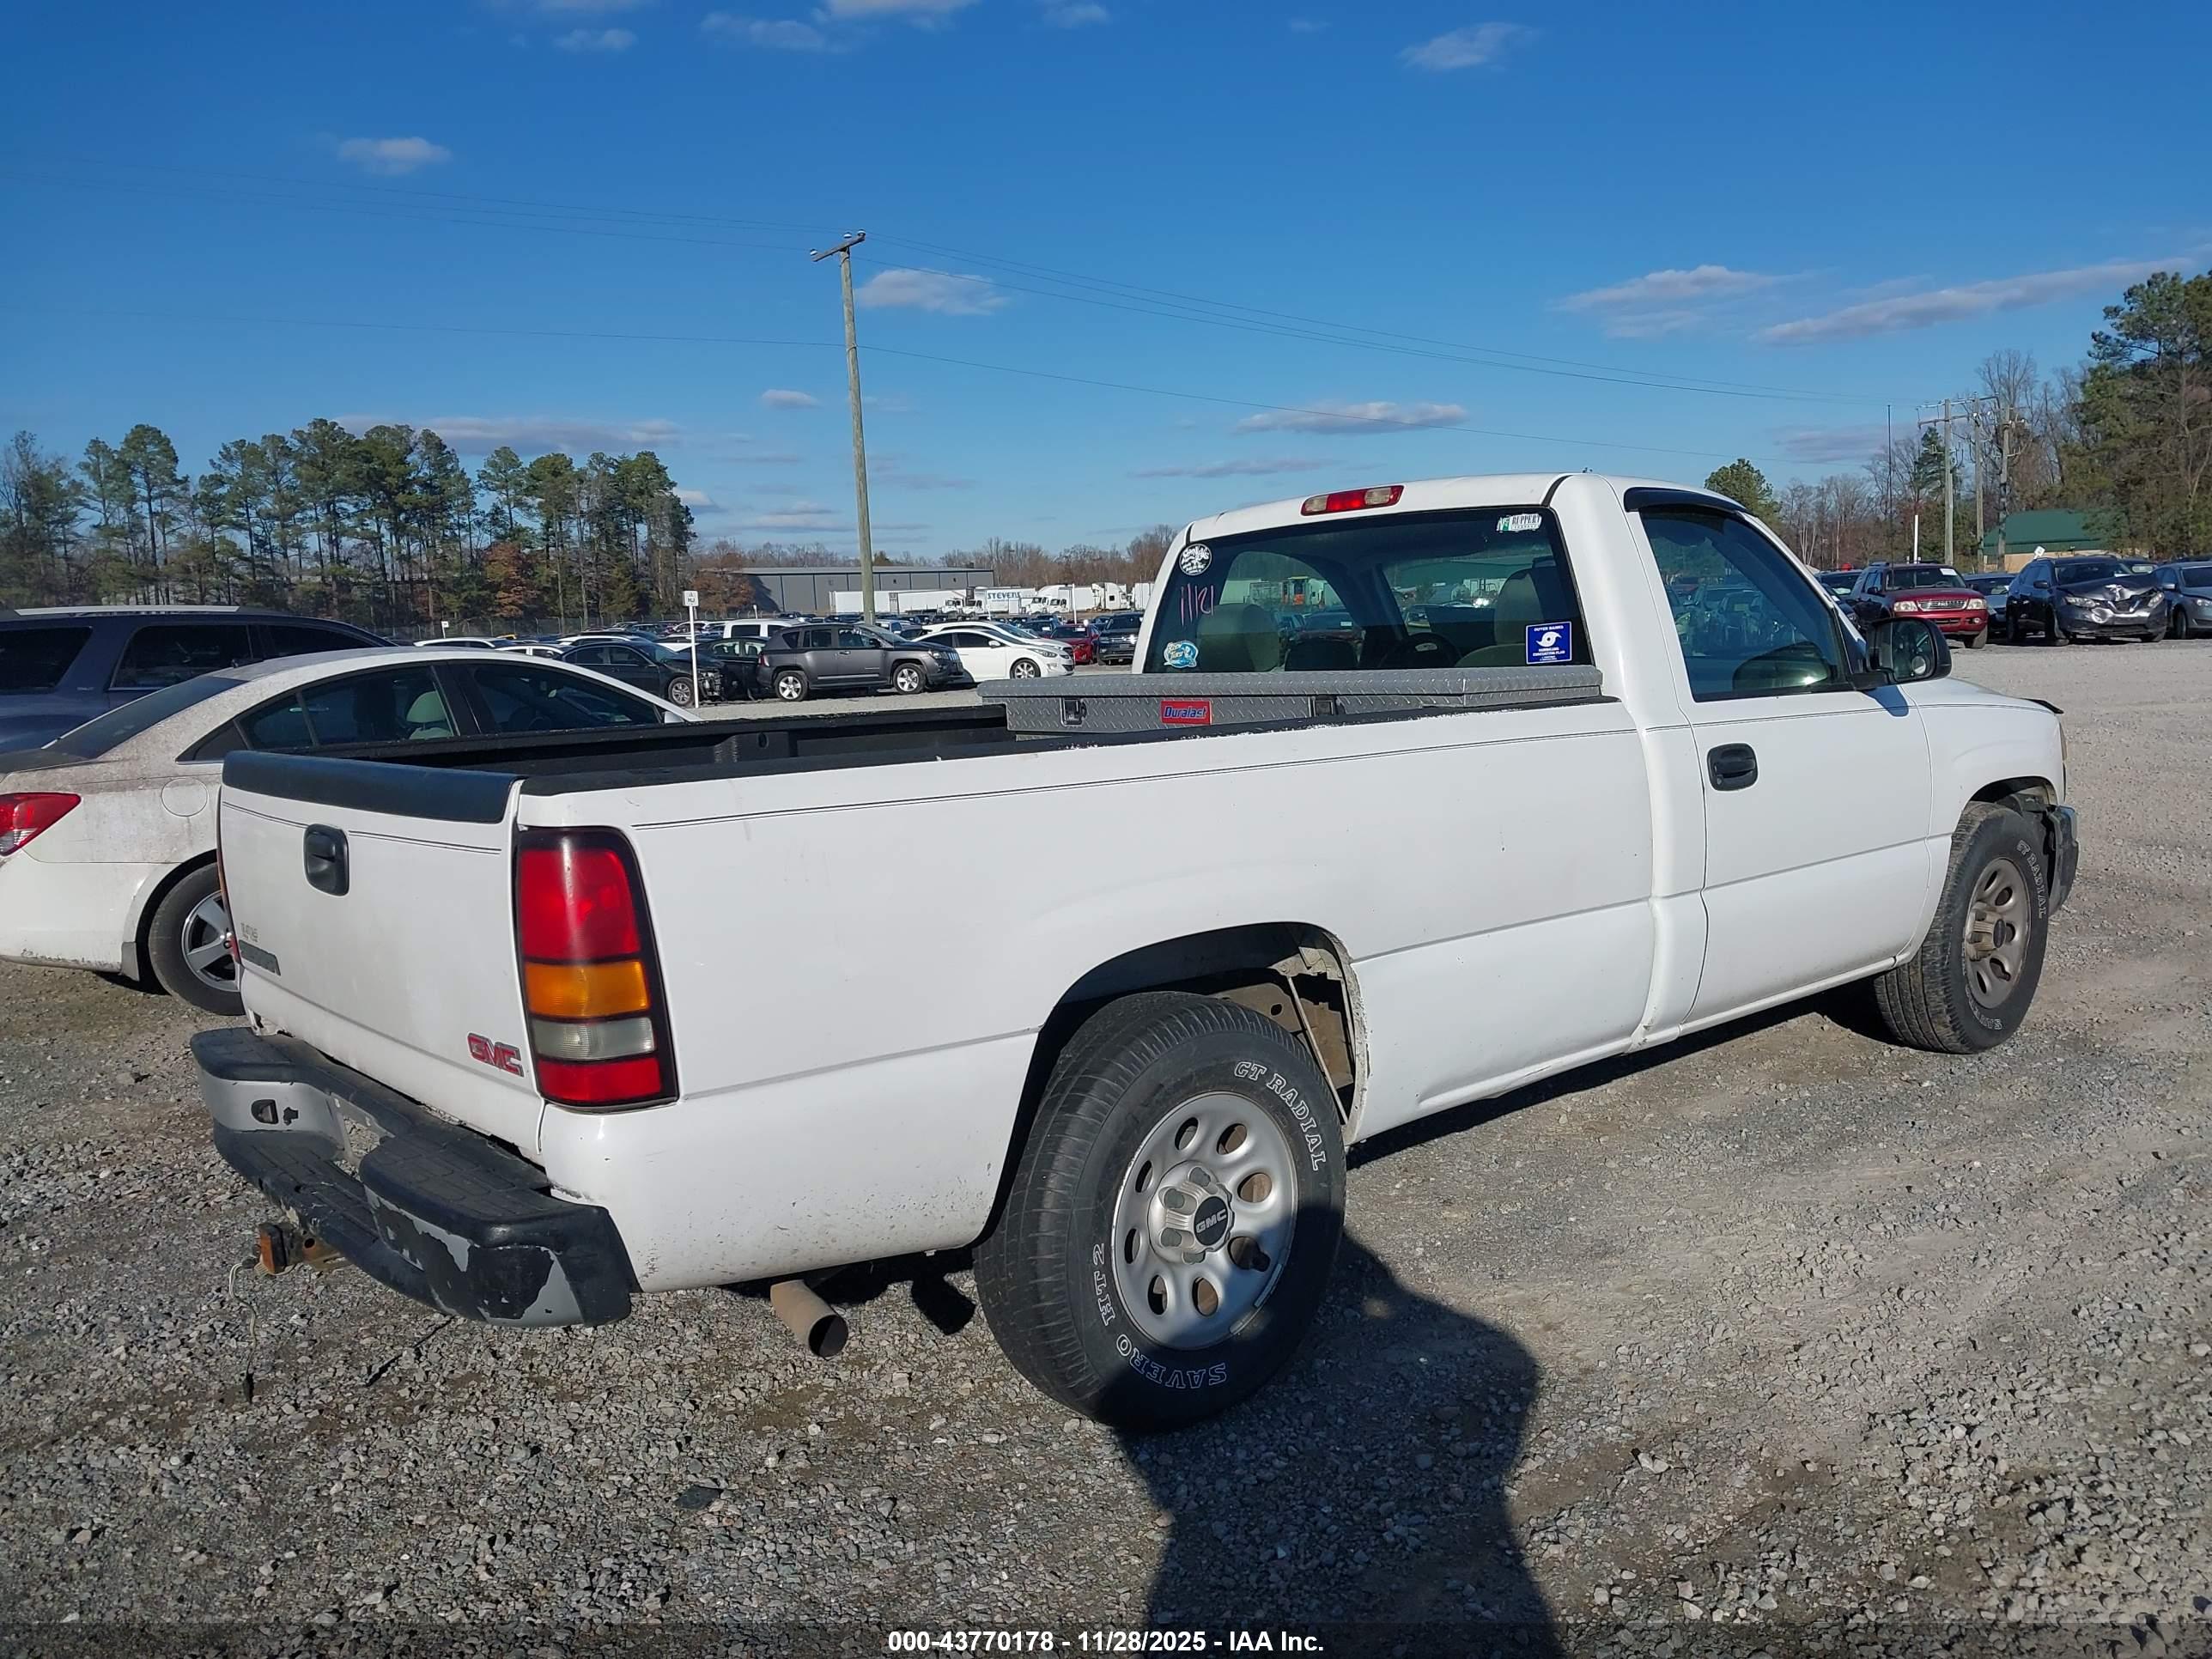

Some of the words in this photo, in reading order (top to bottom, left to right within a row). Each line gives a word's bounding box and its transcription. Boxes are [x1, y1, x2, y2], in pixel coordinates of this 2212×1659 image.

[1164, 706, 1207, 719] Duralast
[2027, 853, 2047, 920] RADIAL
[467, 1032, 525, 1078] GMC
[1234, 1061, 1267, 1081] GT
[1266, 1073, 1327, 1171] RADIAL
[1195, 1208, 1227, 1234] GMC
[1115, 1334, 1227, 1389] SAVERO
